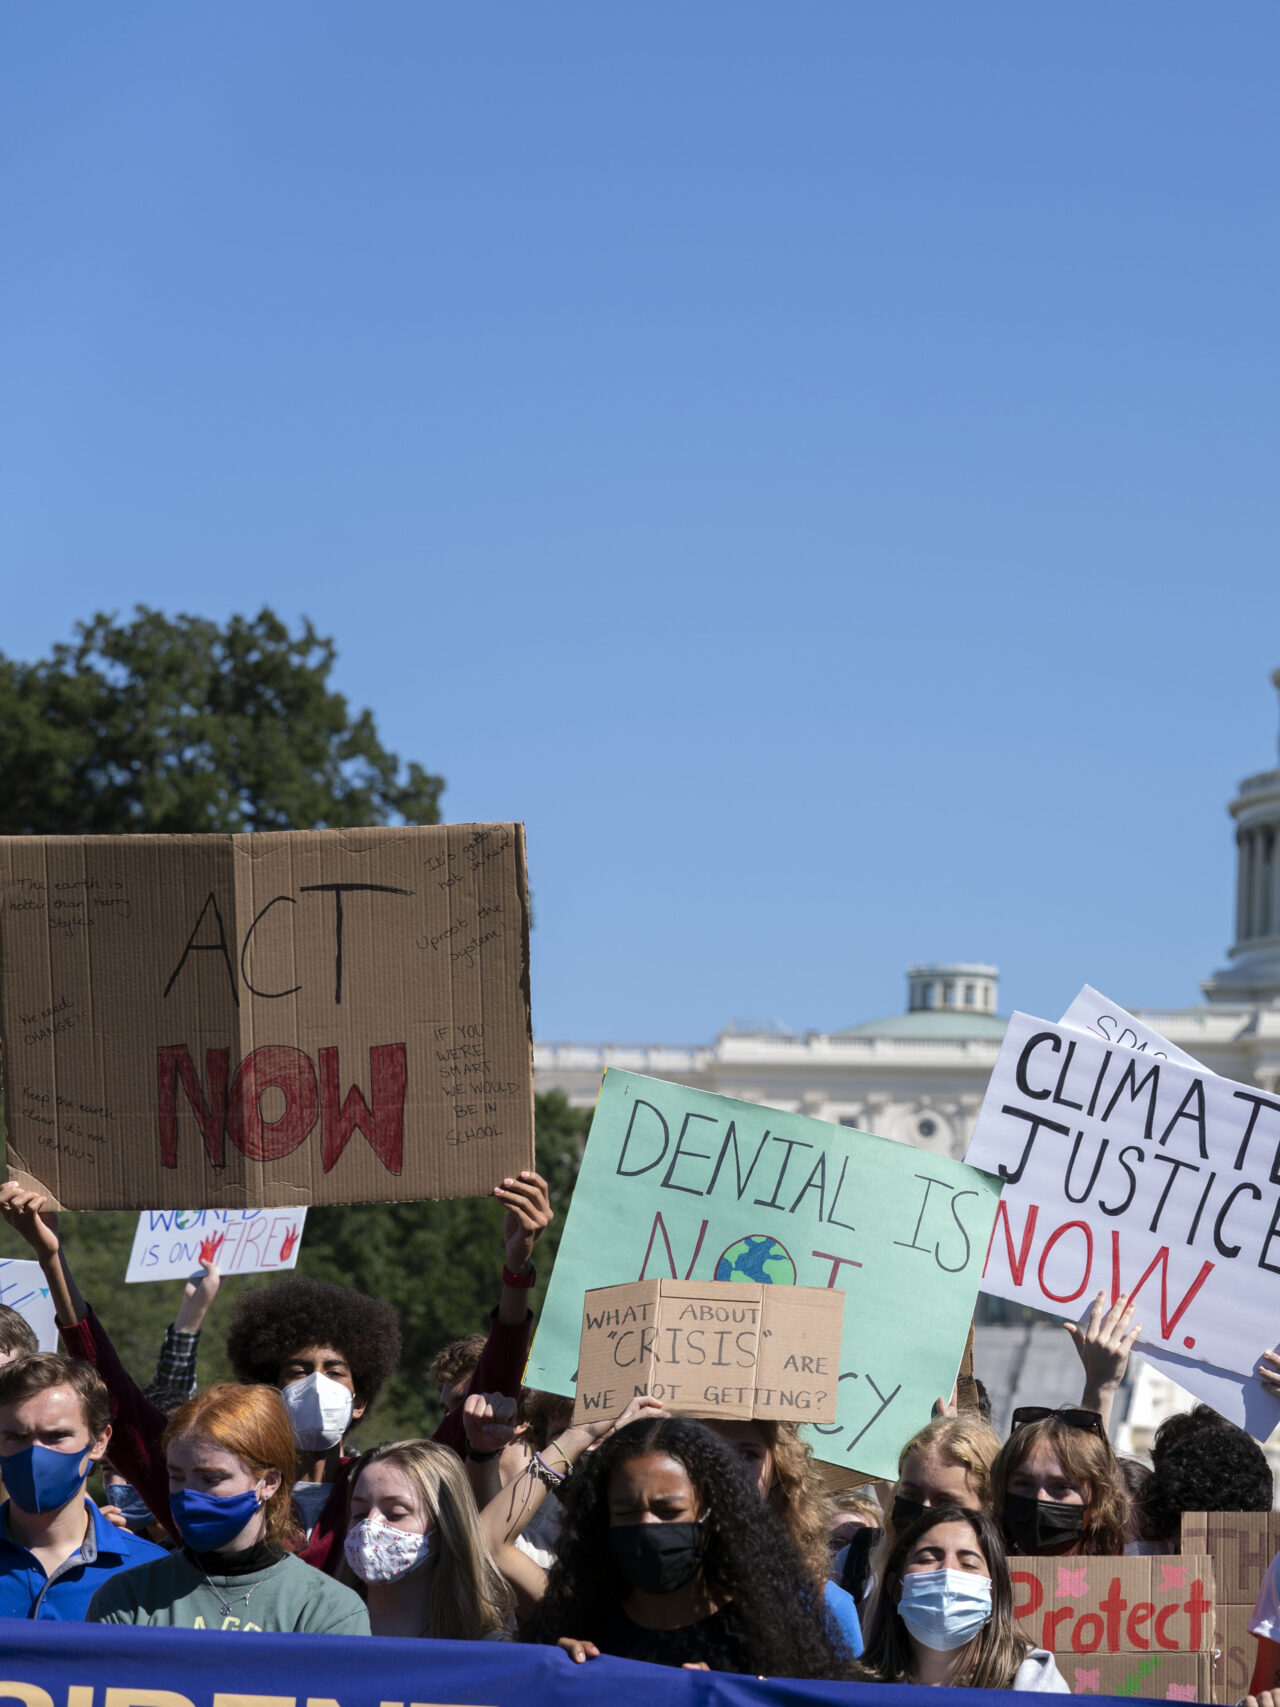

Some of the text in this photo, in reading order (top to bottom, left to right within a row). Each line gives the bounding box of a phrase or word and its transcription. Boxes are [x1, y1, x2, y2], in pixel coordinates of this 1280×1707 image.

[416, 904, 504, 952] Uproot the
[164, 883, 416, 1007] ACT
[434, 1023, 485, 1041] IF YOU
[436, 1044, 485, 1062] WERE
[440, 1060, 492, 1079] SMART
[441, 1080, 520, 1097] WE WOULD
[157, 1042, 407, 1176] NOW
[453, 1101, 497, 1119] BE IN
[445, 1126, 504, 1146] SCHOOL
[616, 1100, 979, 1273] DENIAL IS
[140, 1216, 292, 1270] IS ON FIRE
[983, 1200, 1215, 1349] NOW.
[586, 1303, 760, 1331] WHAT ABOUT
[606, 1327, 773, 1368] "CRISIS"
[783, 1355, 829, 1375] ARE
[583, 1382, 828, 1410] WE NOT GETTING?
[1011, 1571, 1212, 1655] Protect
